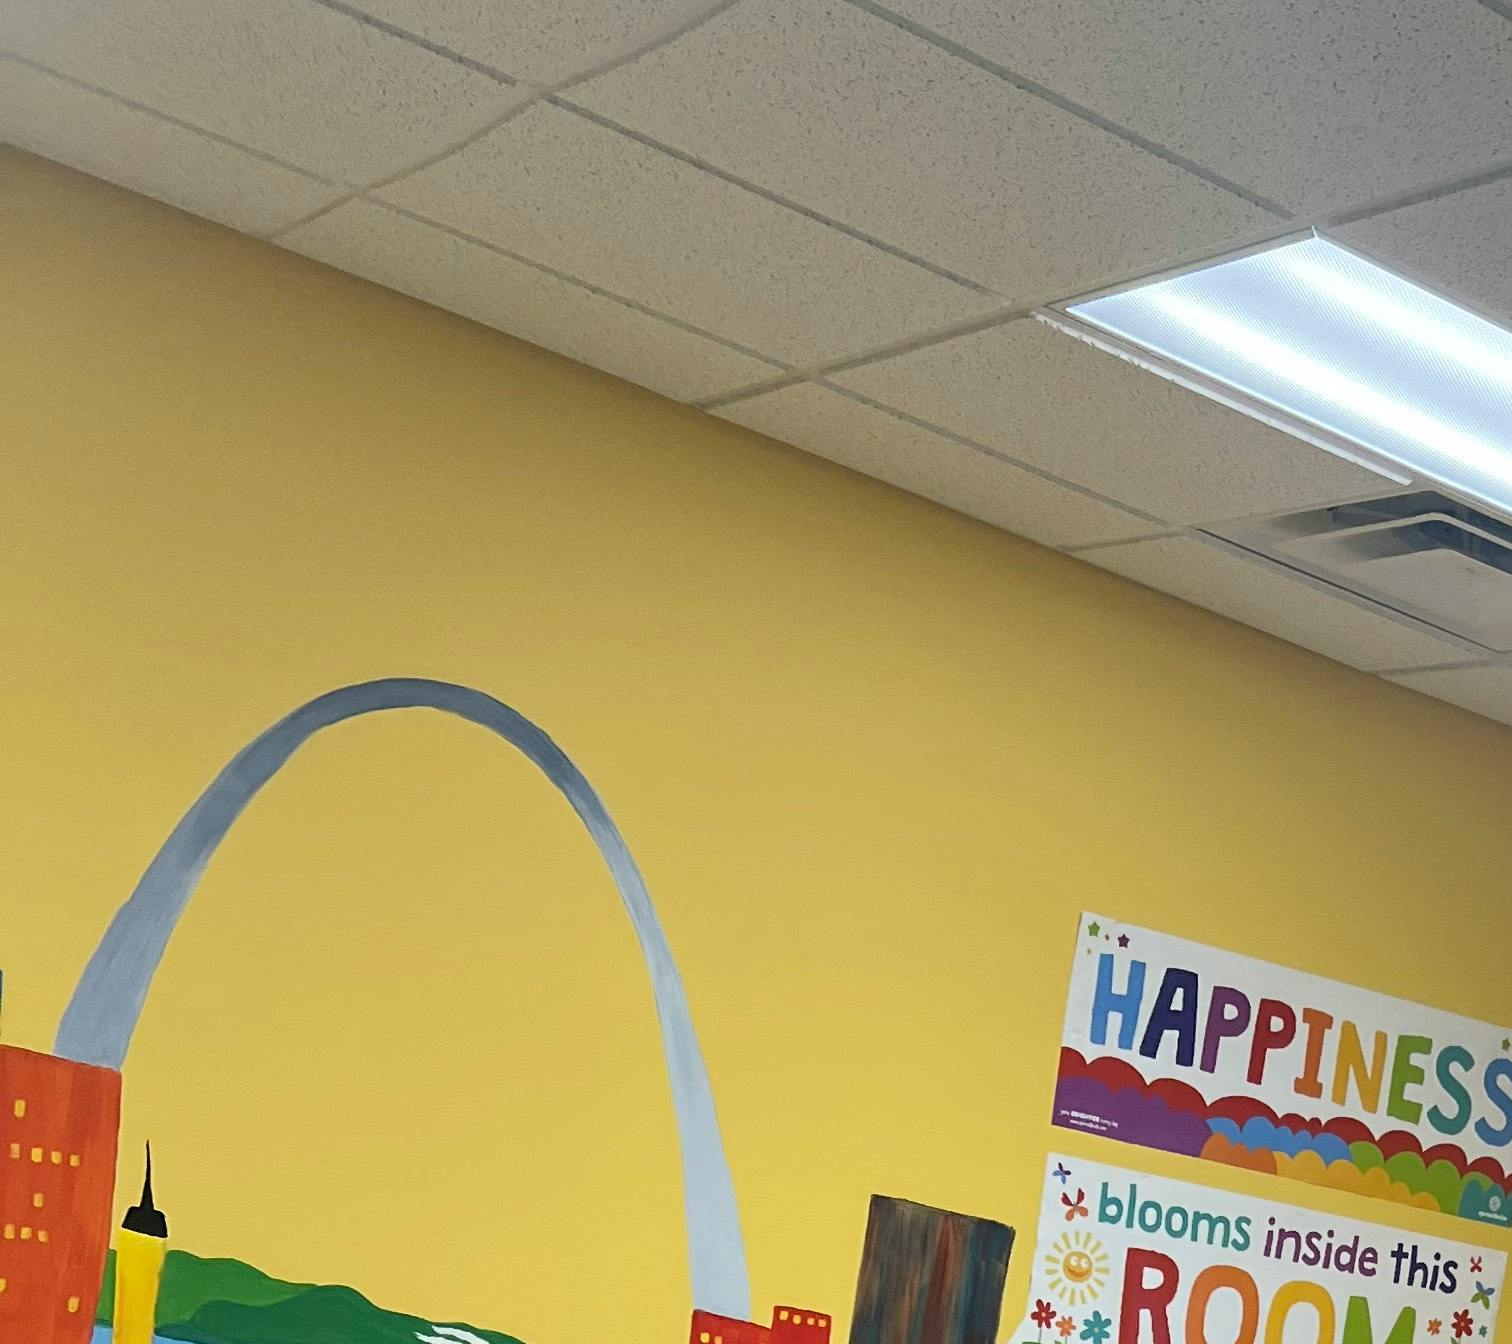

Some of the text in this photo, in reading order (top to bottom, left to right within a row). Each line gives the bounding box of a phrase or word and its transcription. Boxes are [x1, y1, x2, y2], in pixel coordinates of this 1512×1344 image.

[1097, 1181, 1458, 1294] blooms inside this
